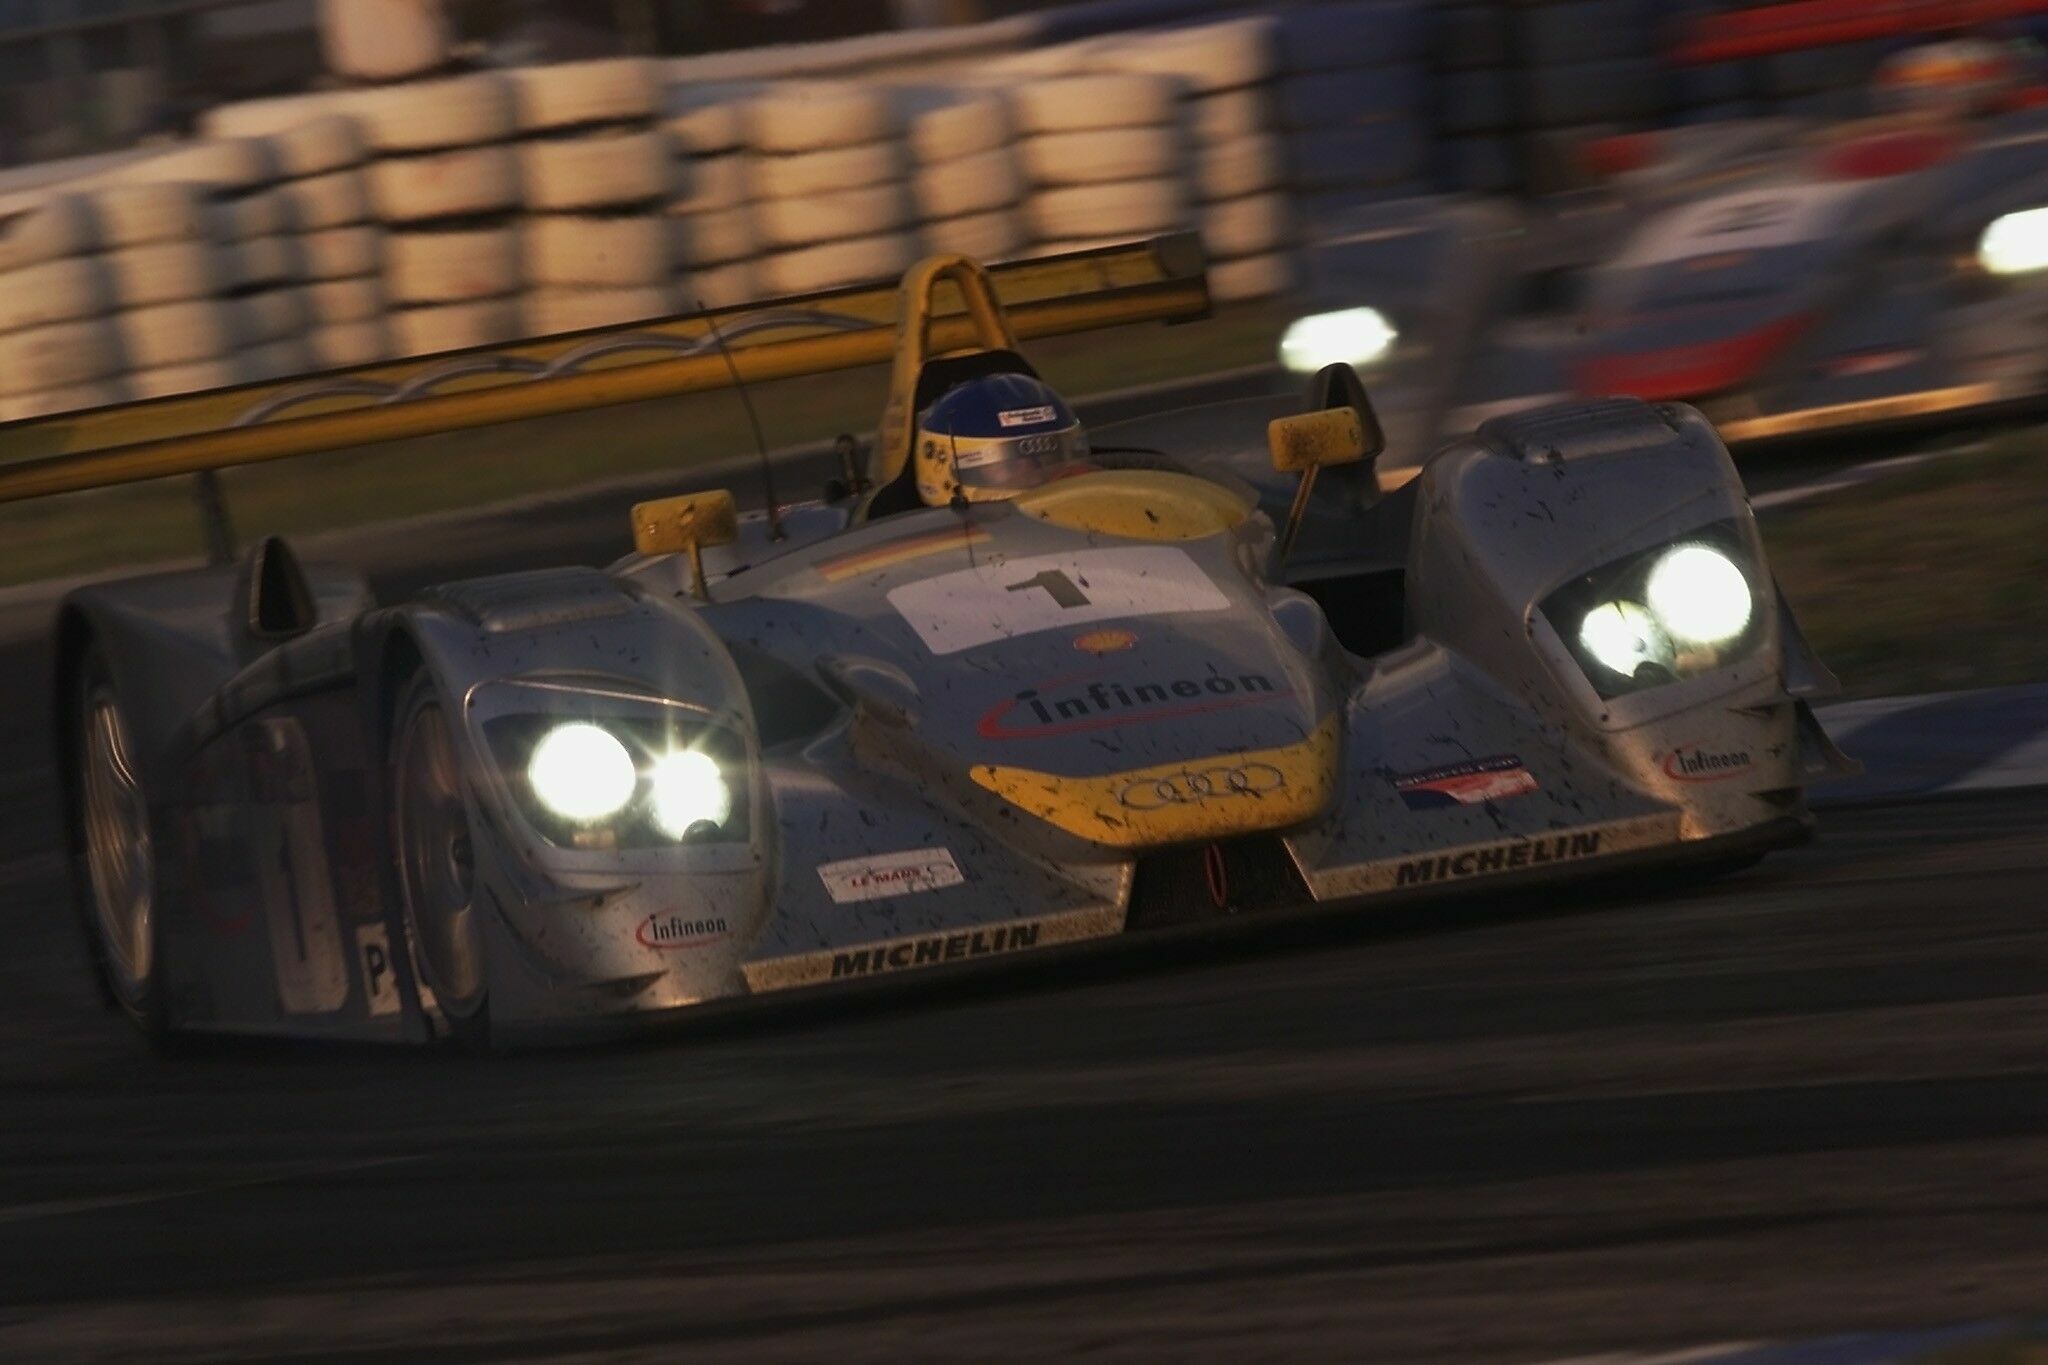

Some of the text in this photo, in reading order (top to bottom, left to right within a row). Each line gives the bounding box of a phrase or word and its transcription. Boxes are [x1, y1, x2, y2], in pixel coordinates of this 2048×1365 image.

[1005, 569, 1092, 609] 1
[1396, 830, 1600, 886] MICHELIN
[831, 923, 1041, 977] MICHELIN
